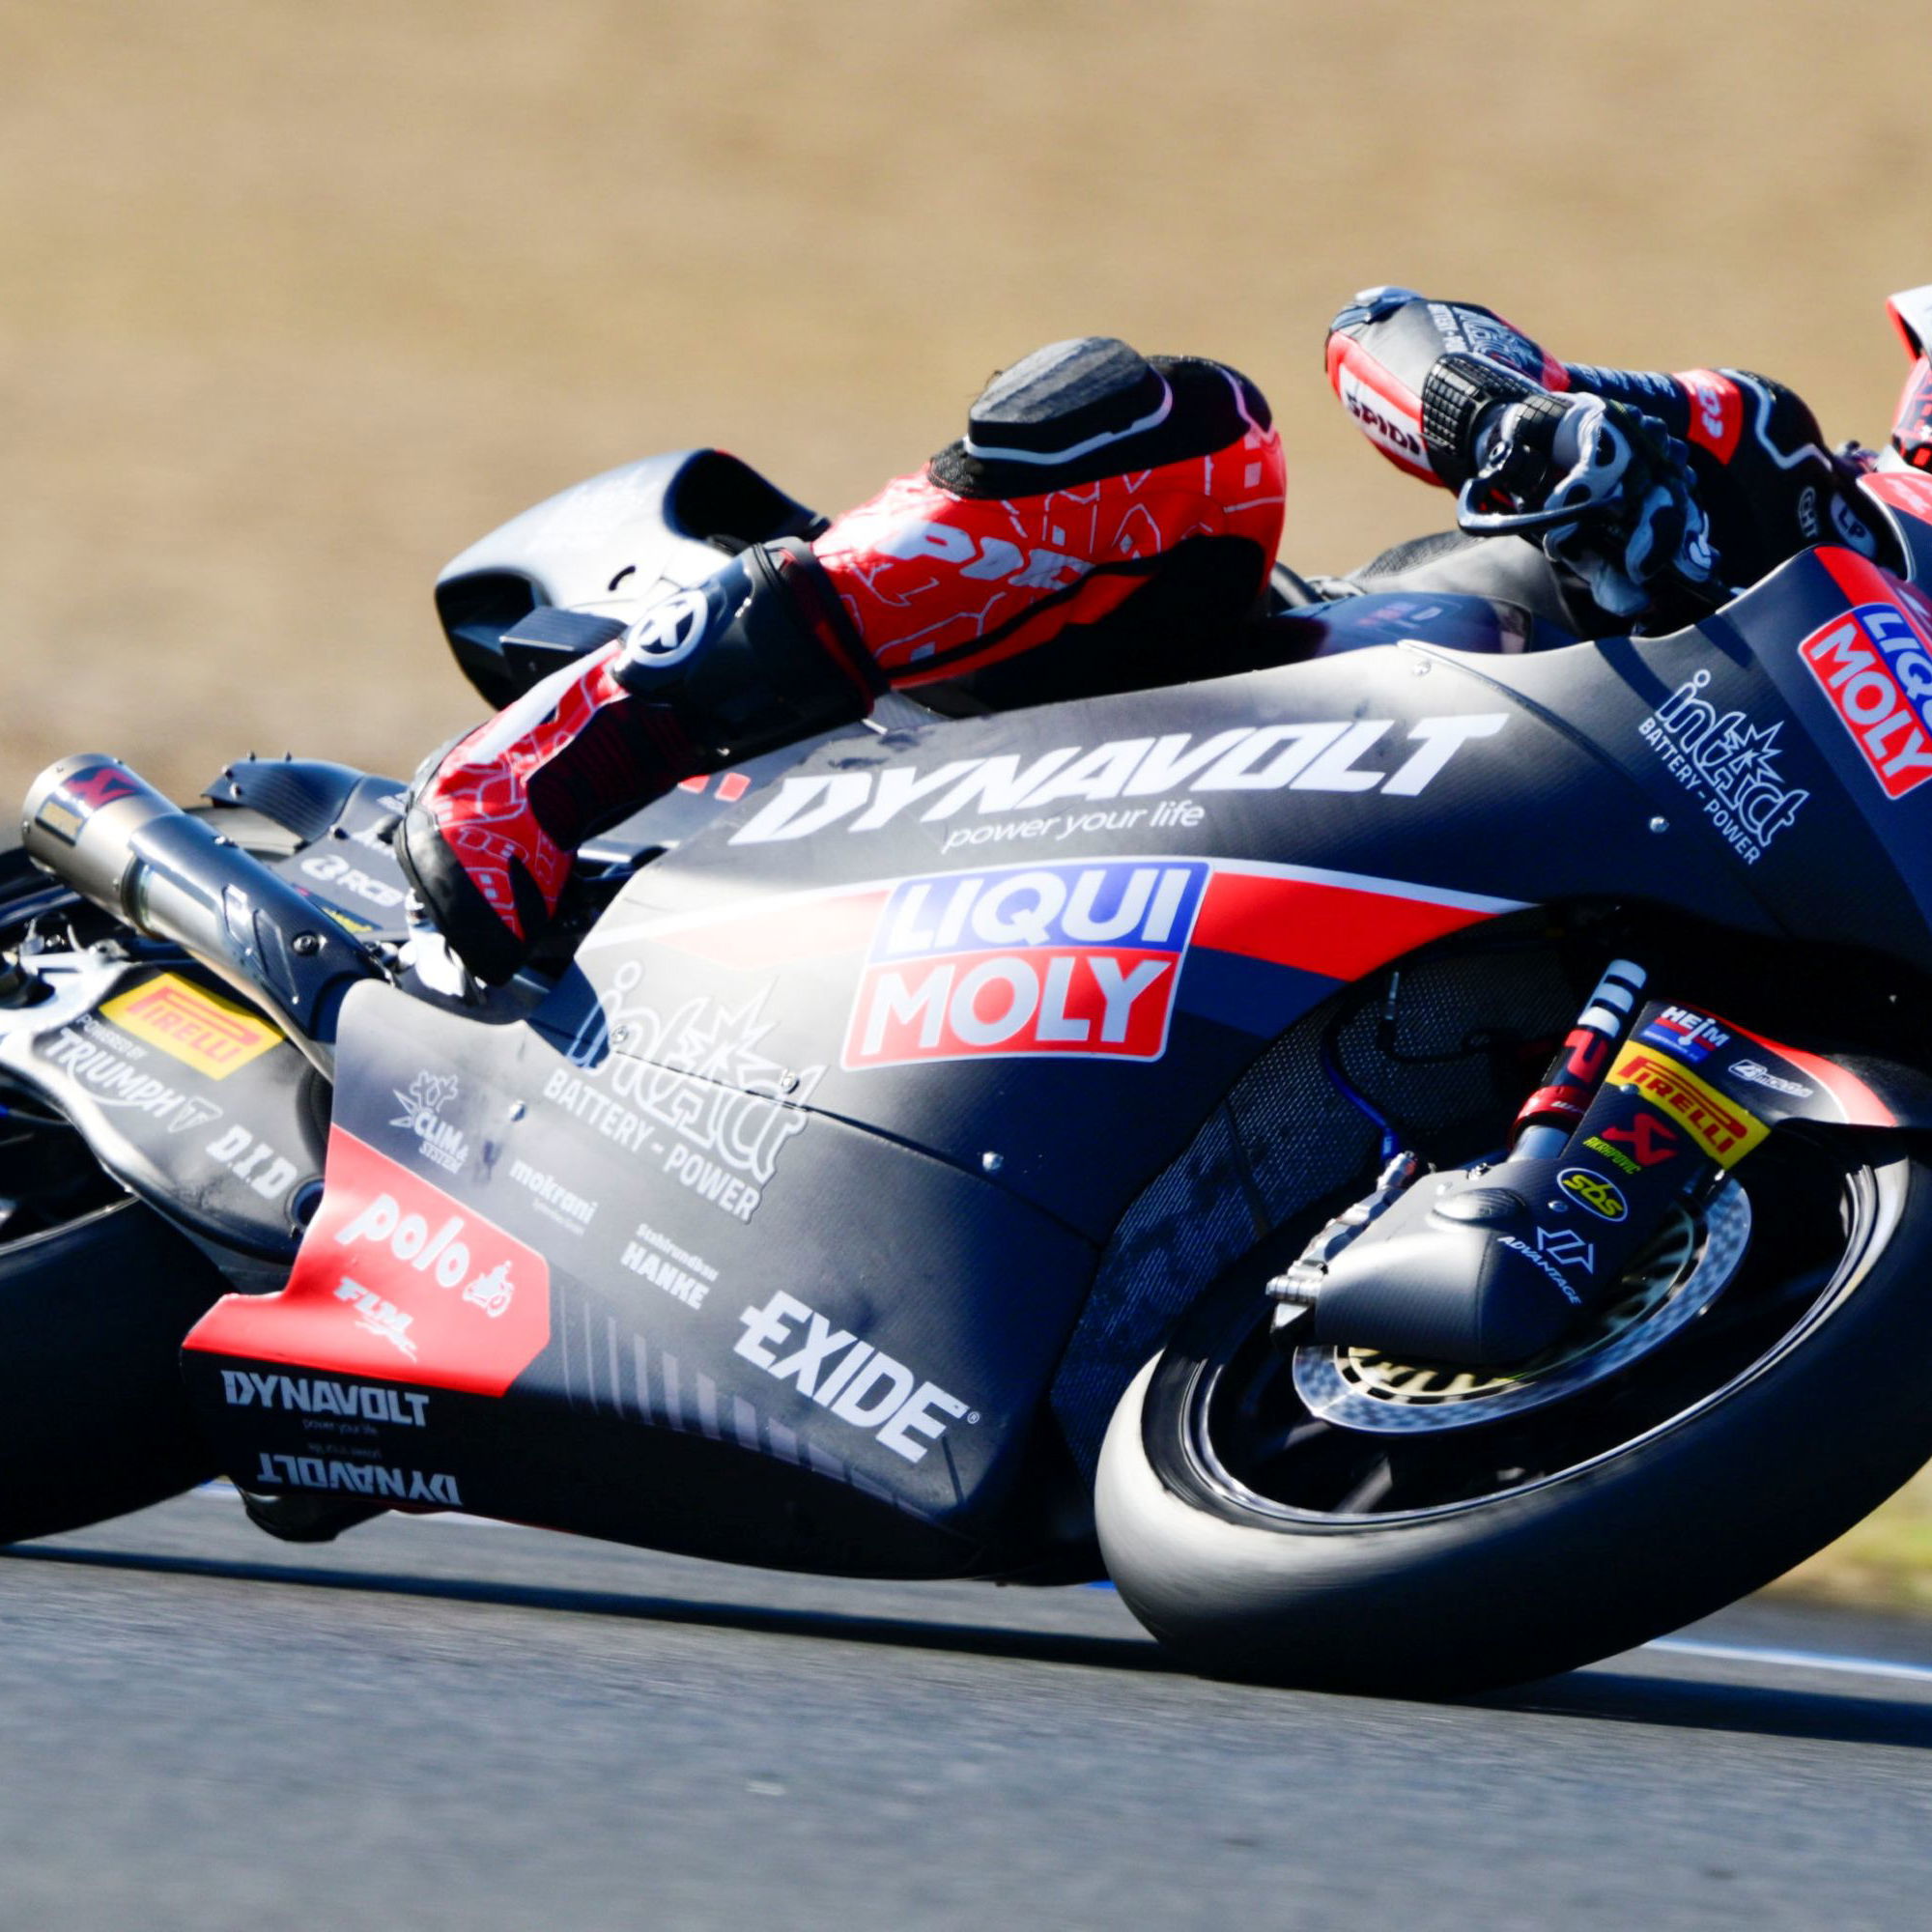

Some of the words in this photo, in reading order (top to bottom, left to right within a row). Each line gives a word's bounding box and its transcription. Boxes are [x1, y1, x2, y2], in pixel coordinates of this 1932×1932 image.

[1809, 634, 1932, 780] MOLY
[1862, 611, 1932, 732] LIQ
[726, 713, 1511, 845] DYNAVOLT
[1637, 716, 1700, 795] BATTERY
[1703, 797, 1762, 866] POWER
[942, 815, 1051, 855] power
[1057, 810, 1147, 849] your
[1149, 799, 1206, 831] life
[885, 867, 1188, 954] LIQUI
[126, 985, 262, 1064] PIRELLI
[860, 956, 1171, 1056] MOLY
[46, 1027, 185, 1118] TRIUMPH
[1617, 1054, 1748, 1156] PIRELLI
[543, 1068, 655, 1153] BATTERY
[663, 1143, 761, 1222] POWER
[1562, 1173, 1624, 1217] sbs
[334, 1194, 470, 1289] polo
[620, 1240, 710, 1310] HANKE
[1497, 1235, 1583, 1306] ADVANTAGE
[220, 1369, 430, 1427] DYNAVOLT
[257, 1452, 463, 1507] DYNAVOLT
